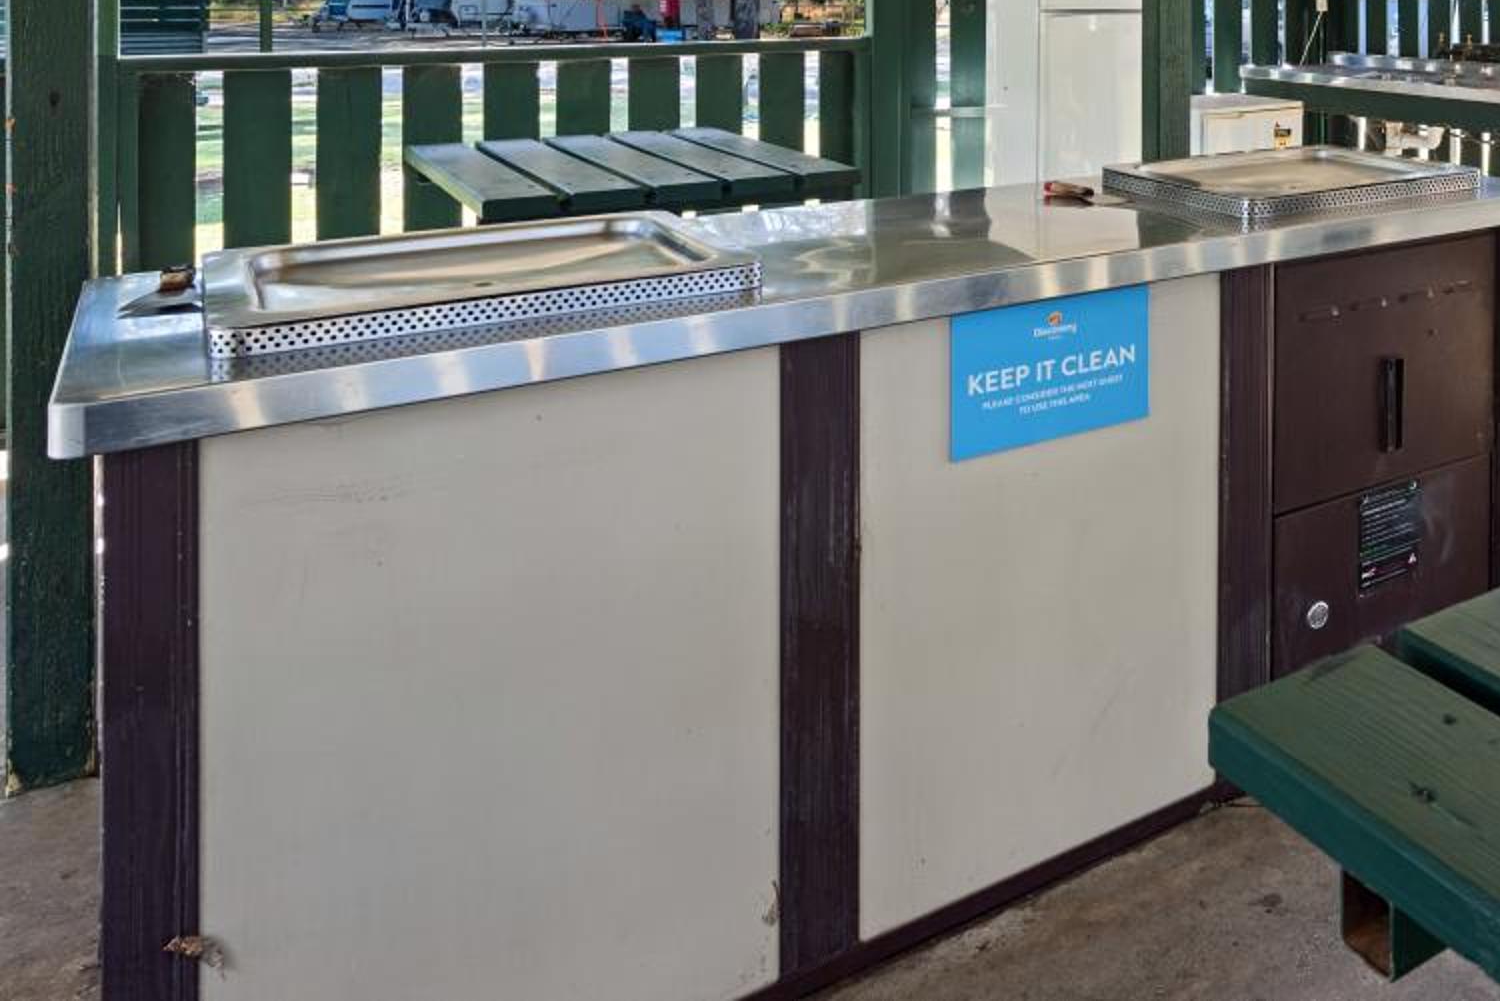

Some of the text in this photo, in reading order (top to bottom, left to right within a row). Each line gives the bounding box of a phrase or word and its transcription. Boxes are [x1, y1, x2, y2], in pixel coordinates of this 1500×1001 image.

[967, 343, 1136, 396] KEEP IT CLEAN
